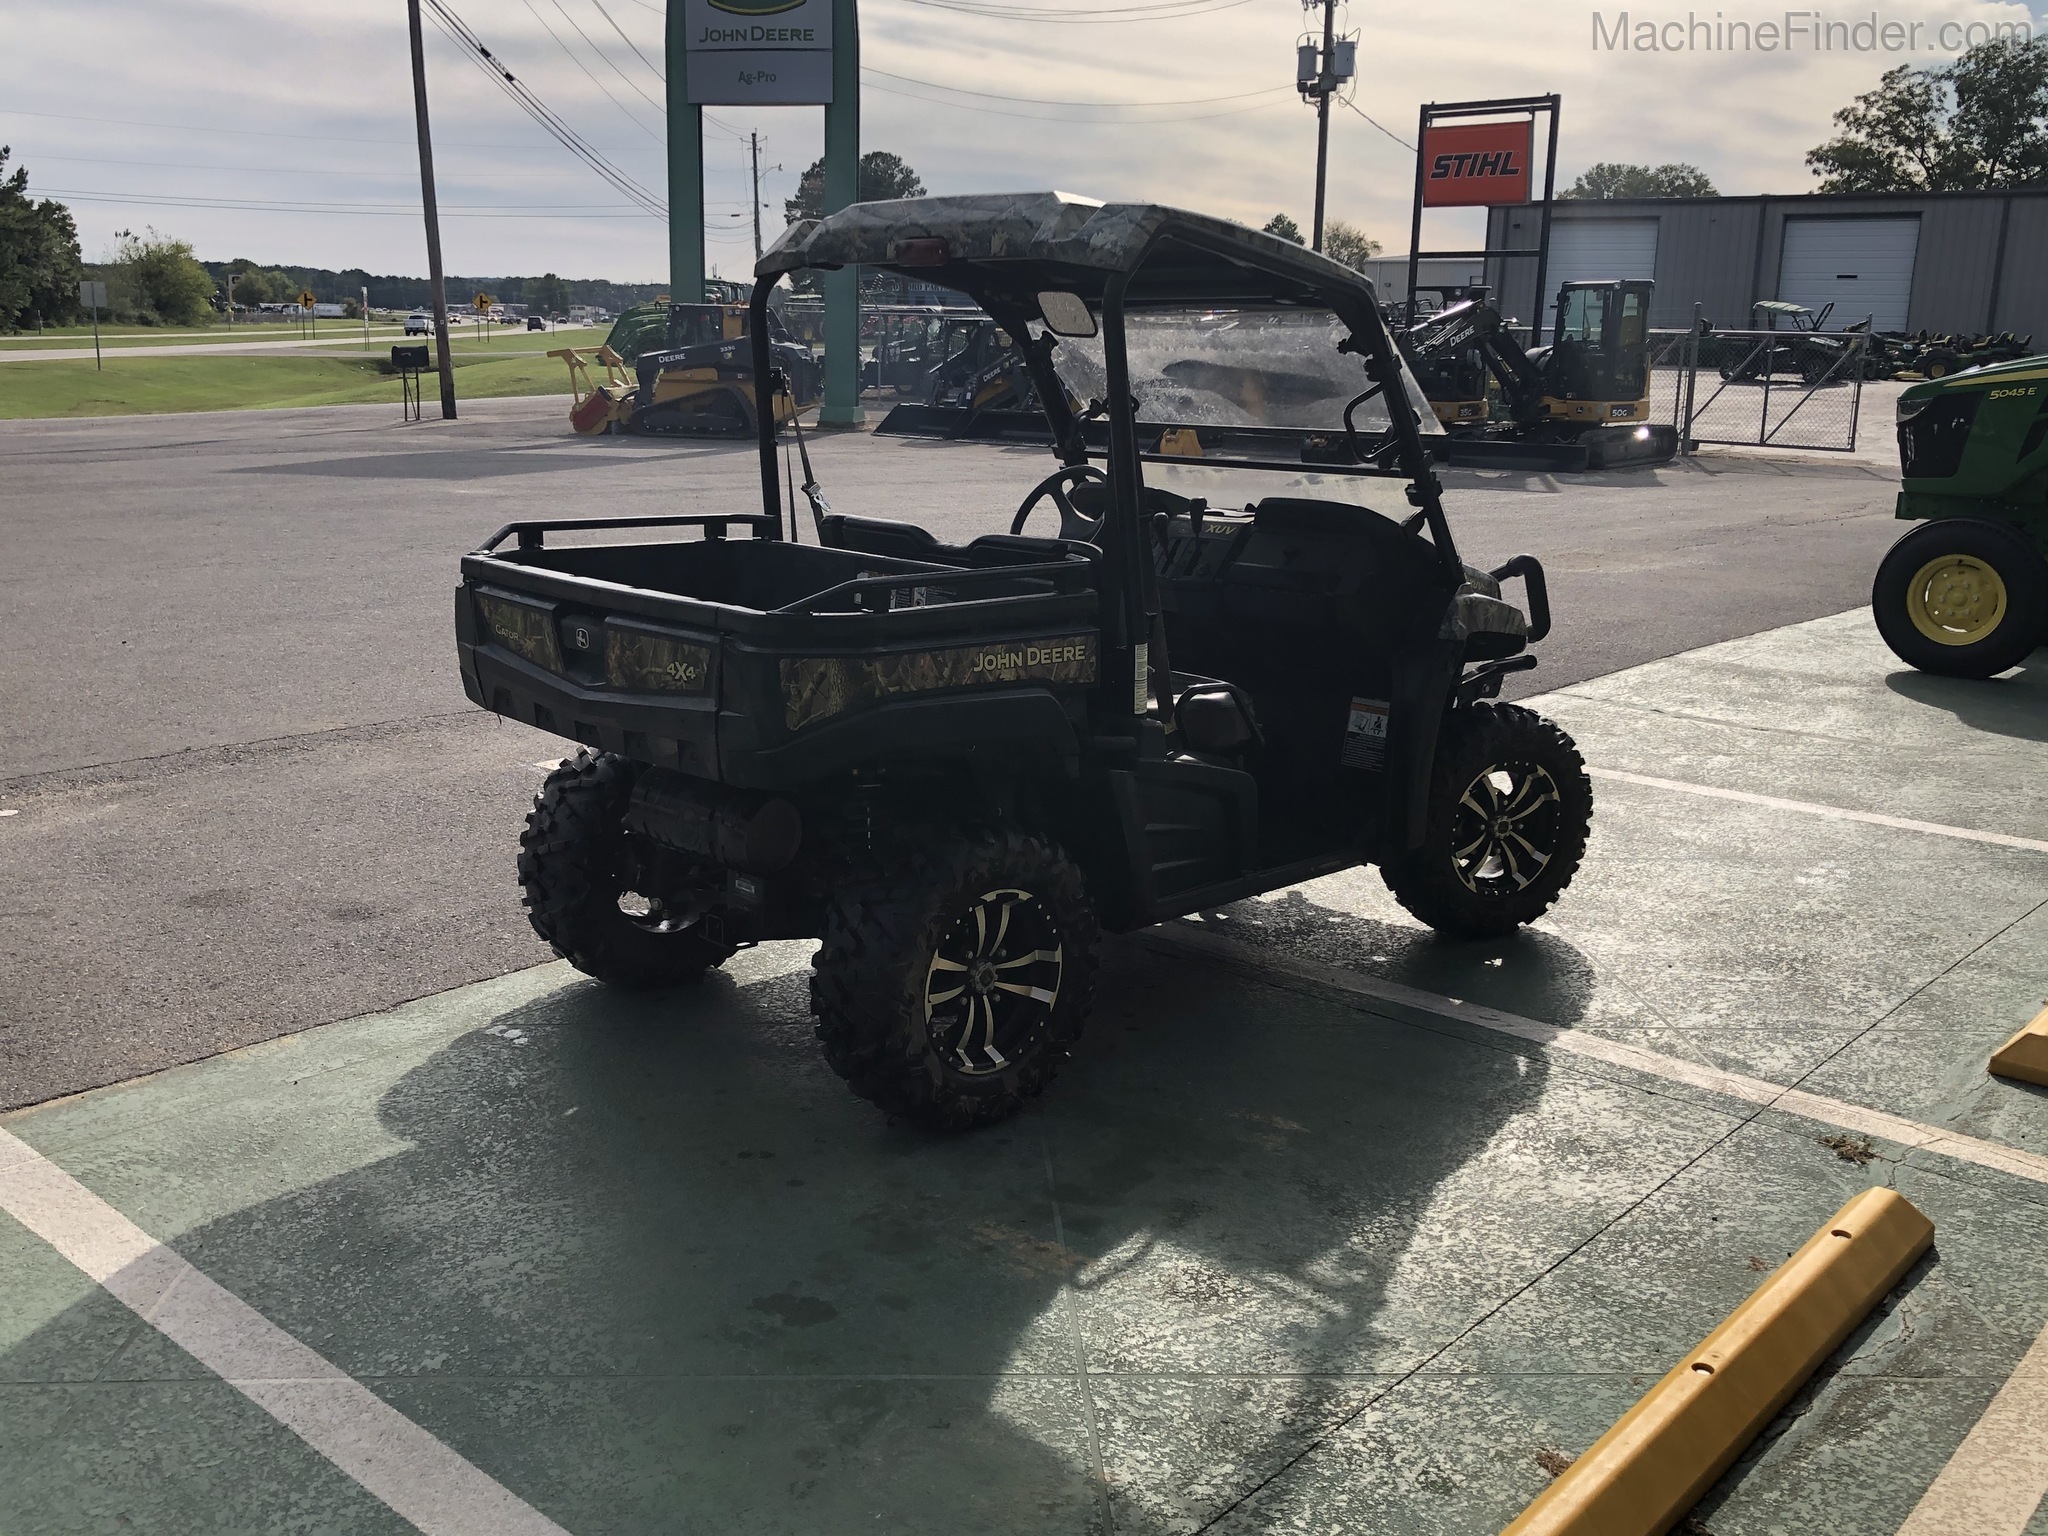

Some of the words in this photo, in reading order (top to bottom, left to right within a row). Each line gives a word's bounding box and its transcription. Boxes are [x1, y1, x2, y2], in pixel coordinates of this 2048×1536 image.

[698, 26, 748, 43] JOHN
[750, 25, 815, 42] DEERE
[738, 70, 777, 85] Ag-Pro
[1429, 149, 1522, 180] STIHL
[1449, 324, 1475, 347] DEERE
[658, 353, 686, 364] DEERE
[982, 366, 1002, 383] DEERE
[1204, 524, 1238, 535] XUV
[972, 650, 1023, 673] JOHN
[1026, 644, 1087, 667] DEERE
